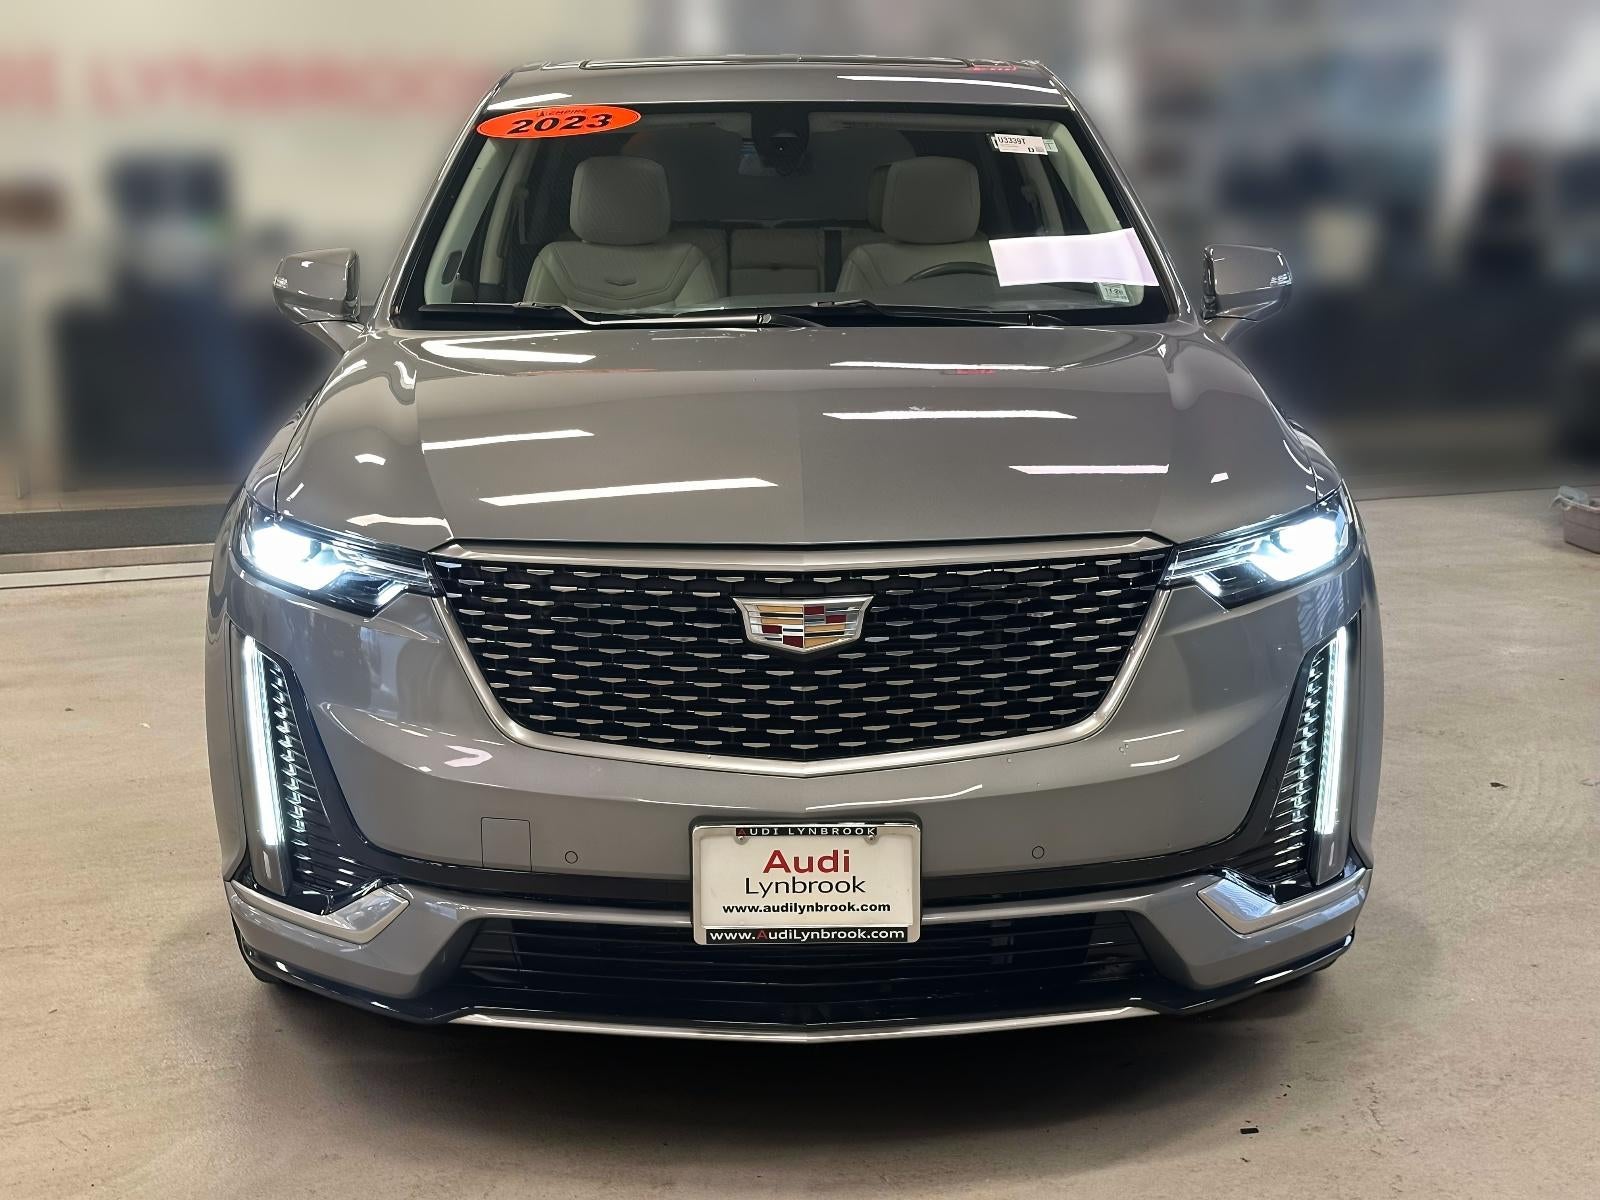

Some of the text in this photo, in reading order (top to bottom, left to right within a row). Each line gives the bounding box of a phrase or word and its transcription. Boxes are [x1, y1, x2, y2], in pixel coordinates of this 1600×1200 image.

[507, 113, 612, 135] 2023
[737, 827, 876, 836] AUDI LYNBROOK
[762, 849, 850, 873] Audi
[745, 876, 866, 898] Lynbrook
[722, 902, 891, 914] www.audilynbrook.com
[710, 929, 905, 942] www.AudiLynbrook.com
